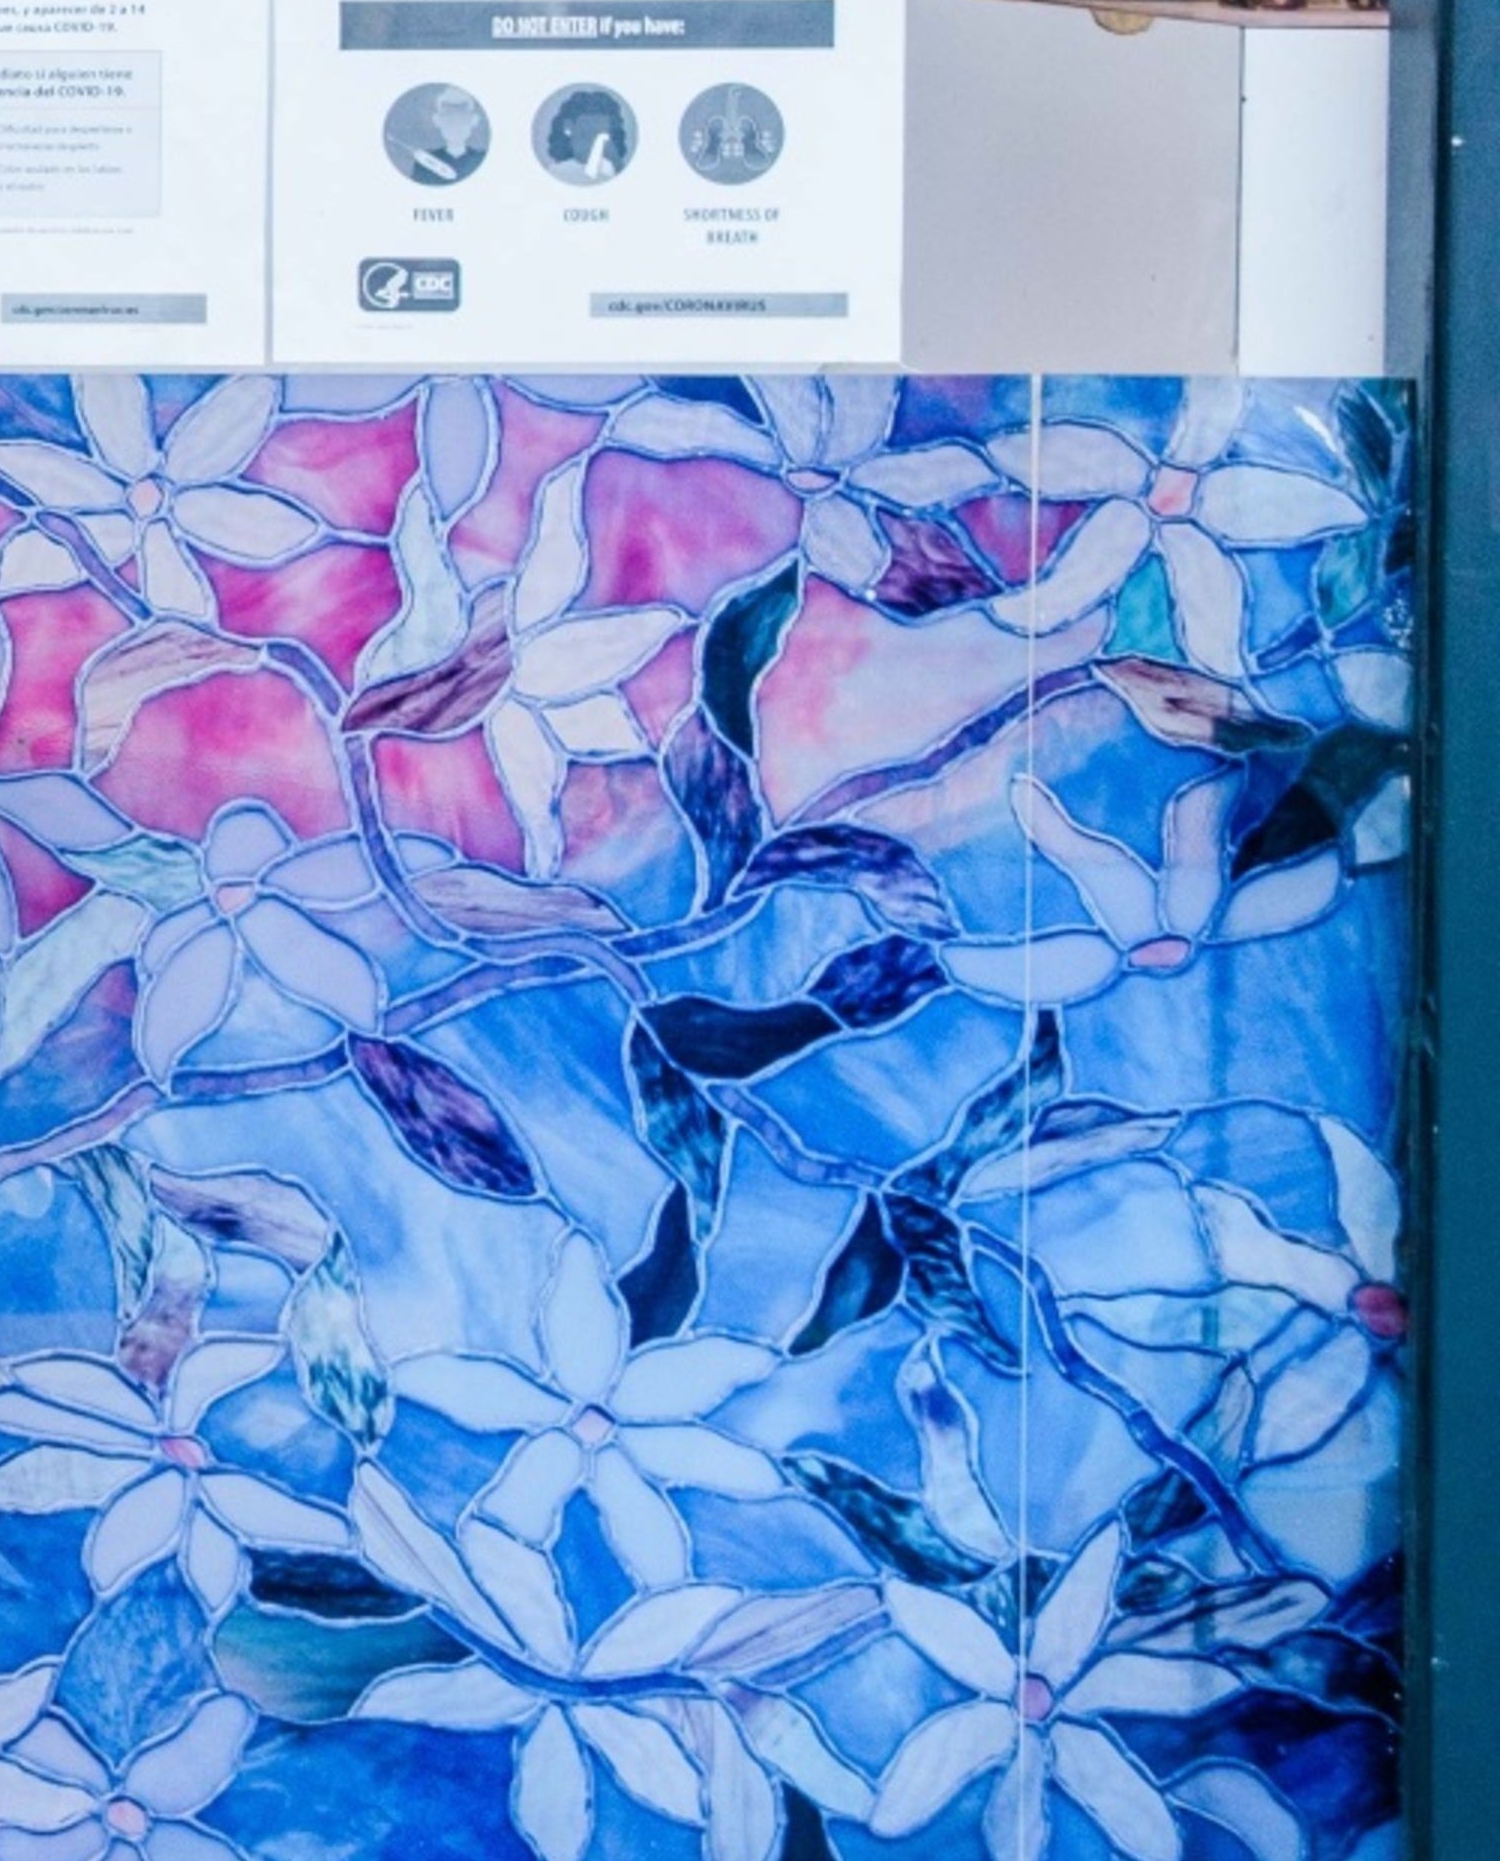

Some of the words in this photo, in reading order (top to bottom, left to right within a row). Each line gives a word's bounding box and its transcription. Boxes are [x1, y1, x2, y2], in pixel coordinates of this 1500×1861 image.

[492, 16, 514, 36] DO
[515, 16, 547, 36] NOT
[550, 16, 598, 36] ENTER
[613, 20, 641, 39] you
[644, 16, 685, 35] have:
[416, 276, 450, 292] CDC
